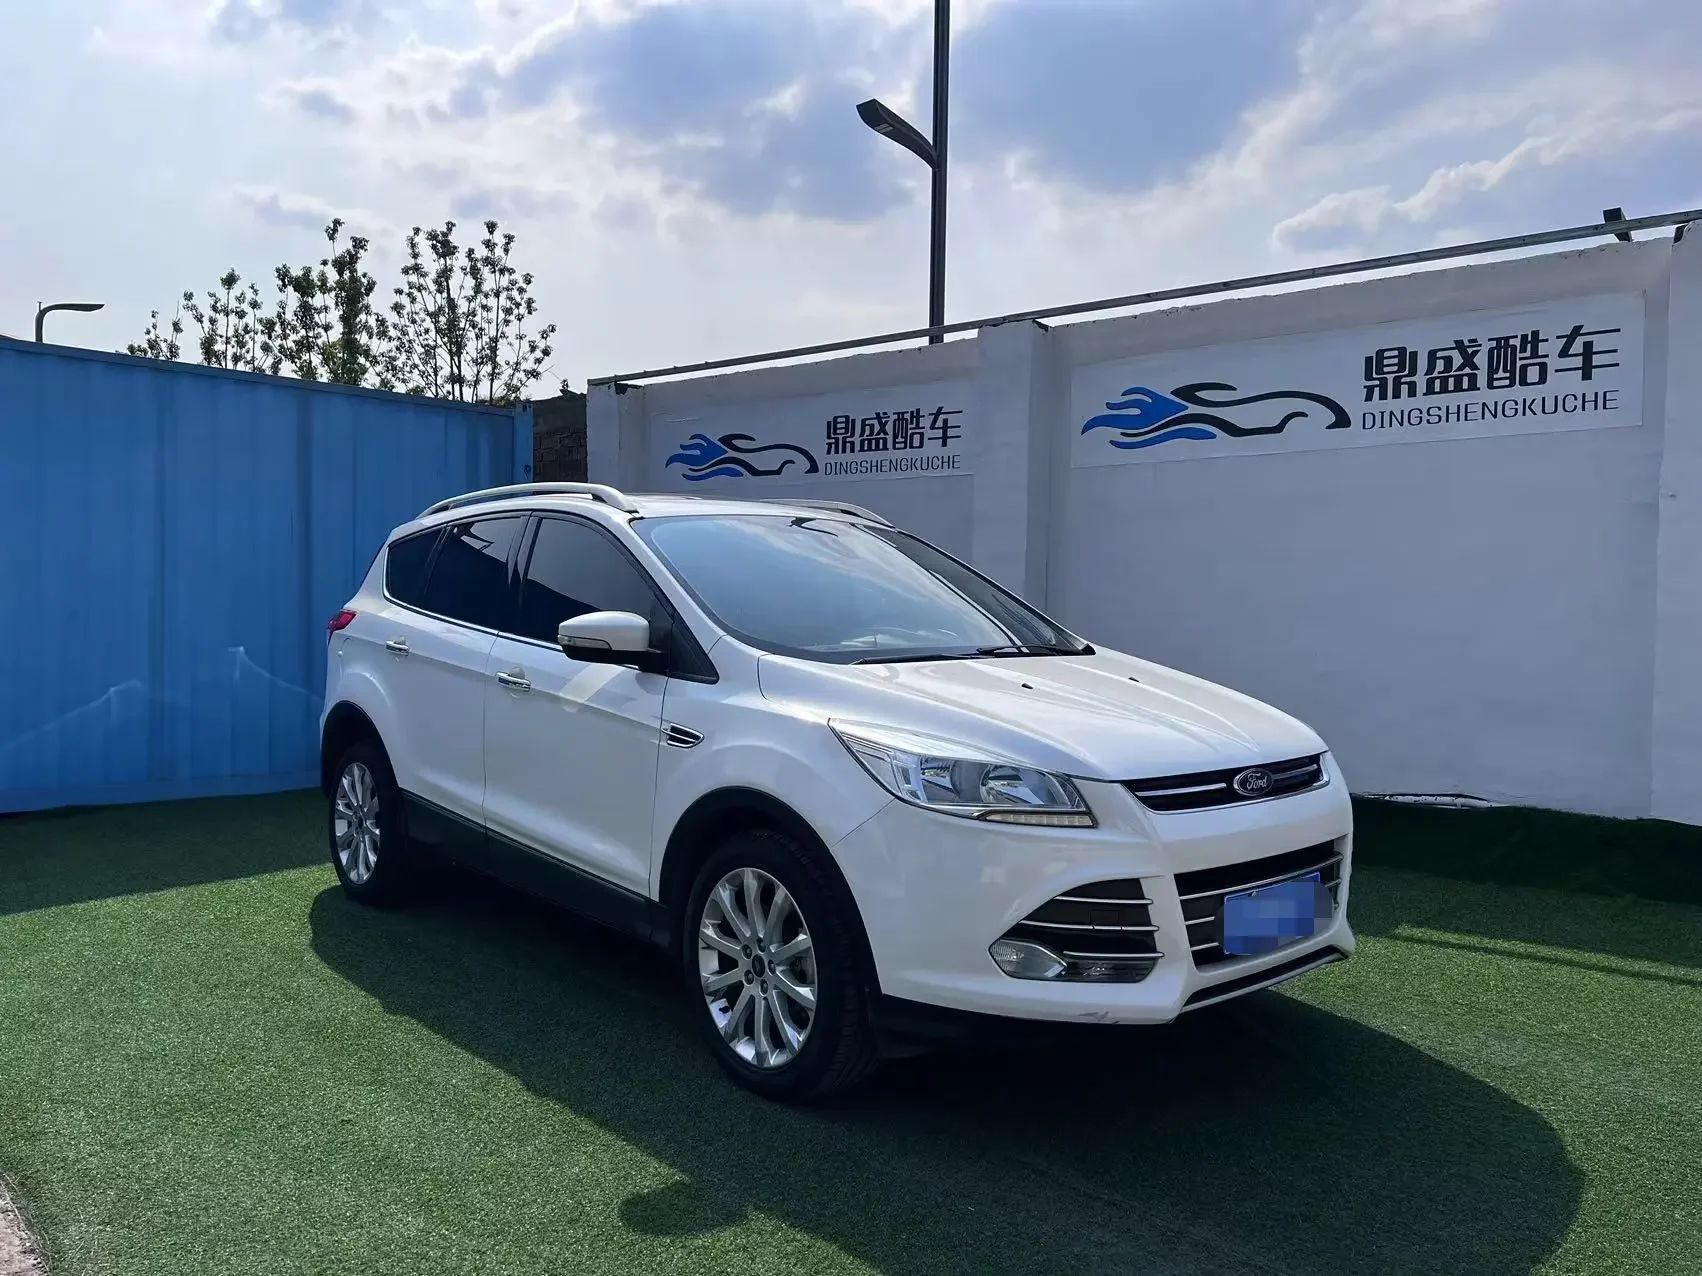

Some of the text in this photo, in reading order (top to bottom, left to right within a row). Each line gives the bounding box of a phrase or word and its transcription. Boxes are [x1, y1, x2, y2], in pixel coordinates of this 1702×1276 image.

[1363, 324, 1621, 402] 鼎盛酷车
[1361, 389, 1620, 430] DINGSHENGKUCHE
[826, 406, 963, 455] 鼎盛酷车
[824, 454, 961, 476] DINGSHENGKUCHE
[1246, 772, 1268, 790] Ford
